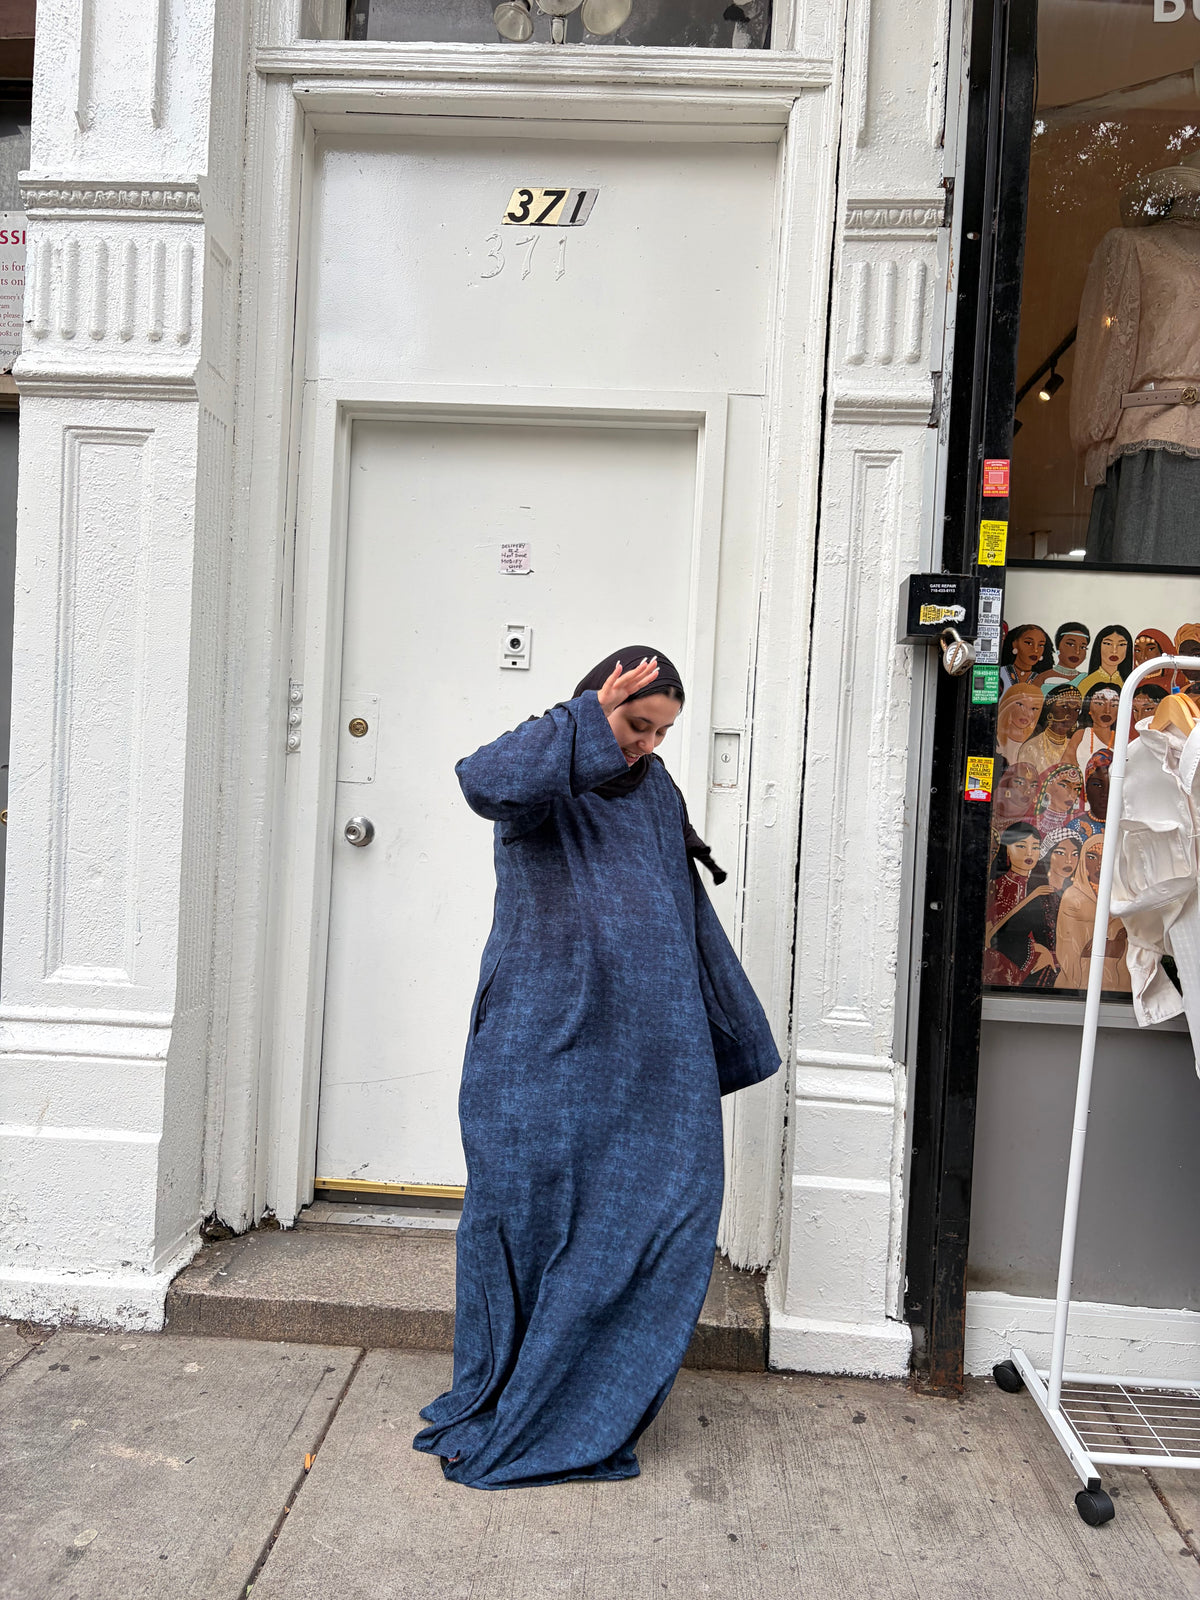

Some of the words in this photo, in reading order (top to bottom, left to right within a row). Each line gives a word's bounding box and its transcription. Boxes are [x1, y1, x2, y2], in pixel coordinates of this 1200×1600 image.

[507, 188, 587, 223] 371
[0, 230, 26, 245] SSI
[2, 261, 9, 272] is
[12, 261, 25, 272] for
[480, 232, 567, 281] 371
